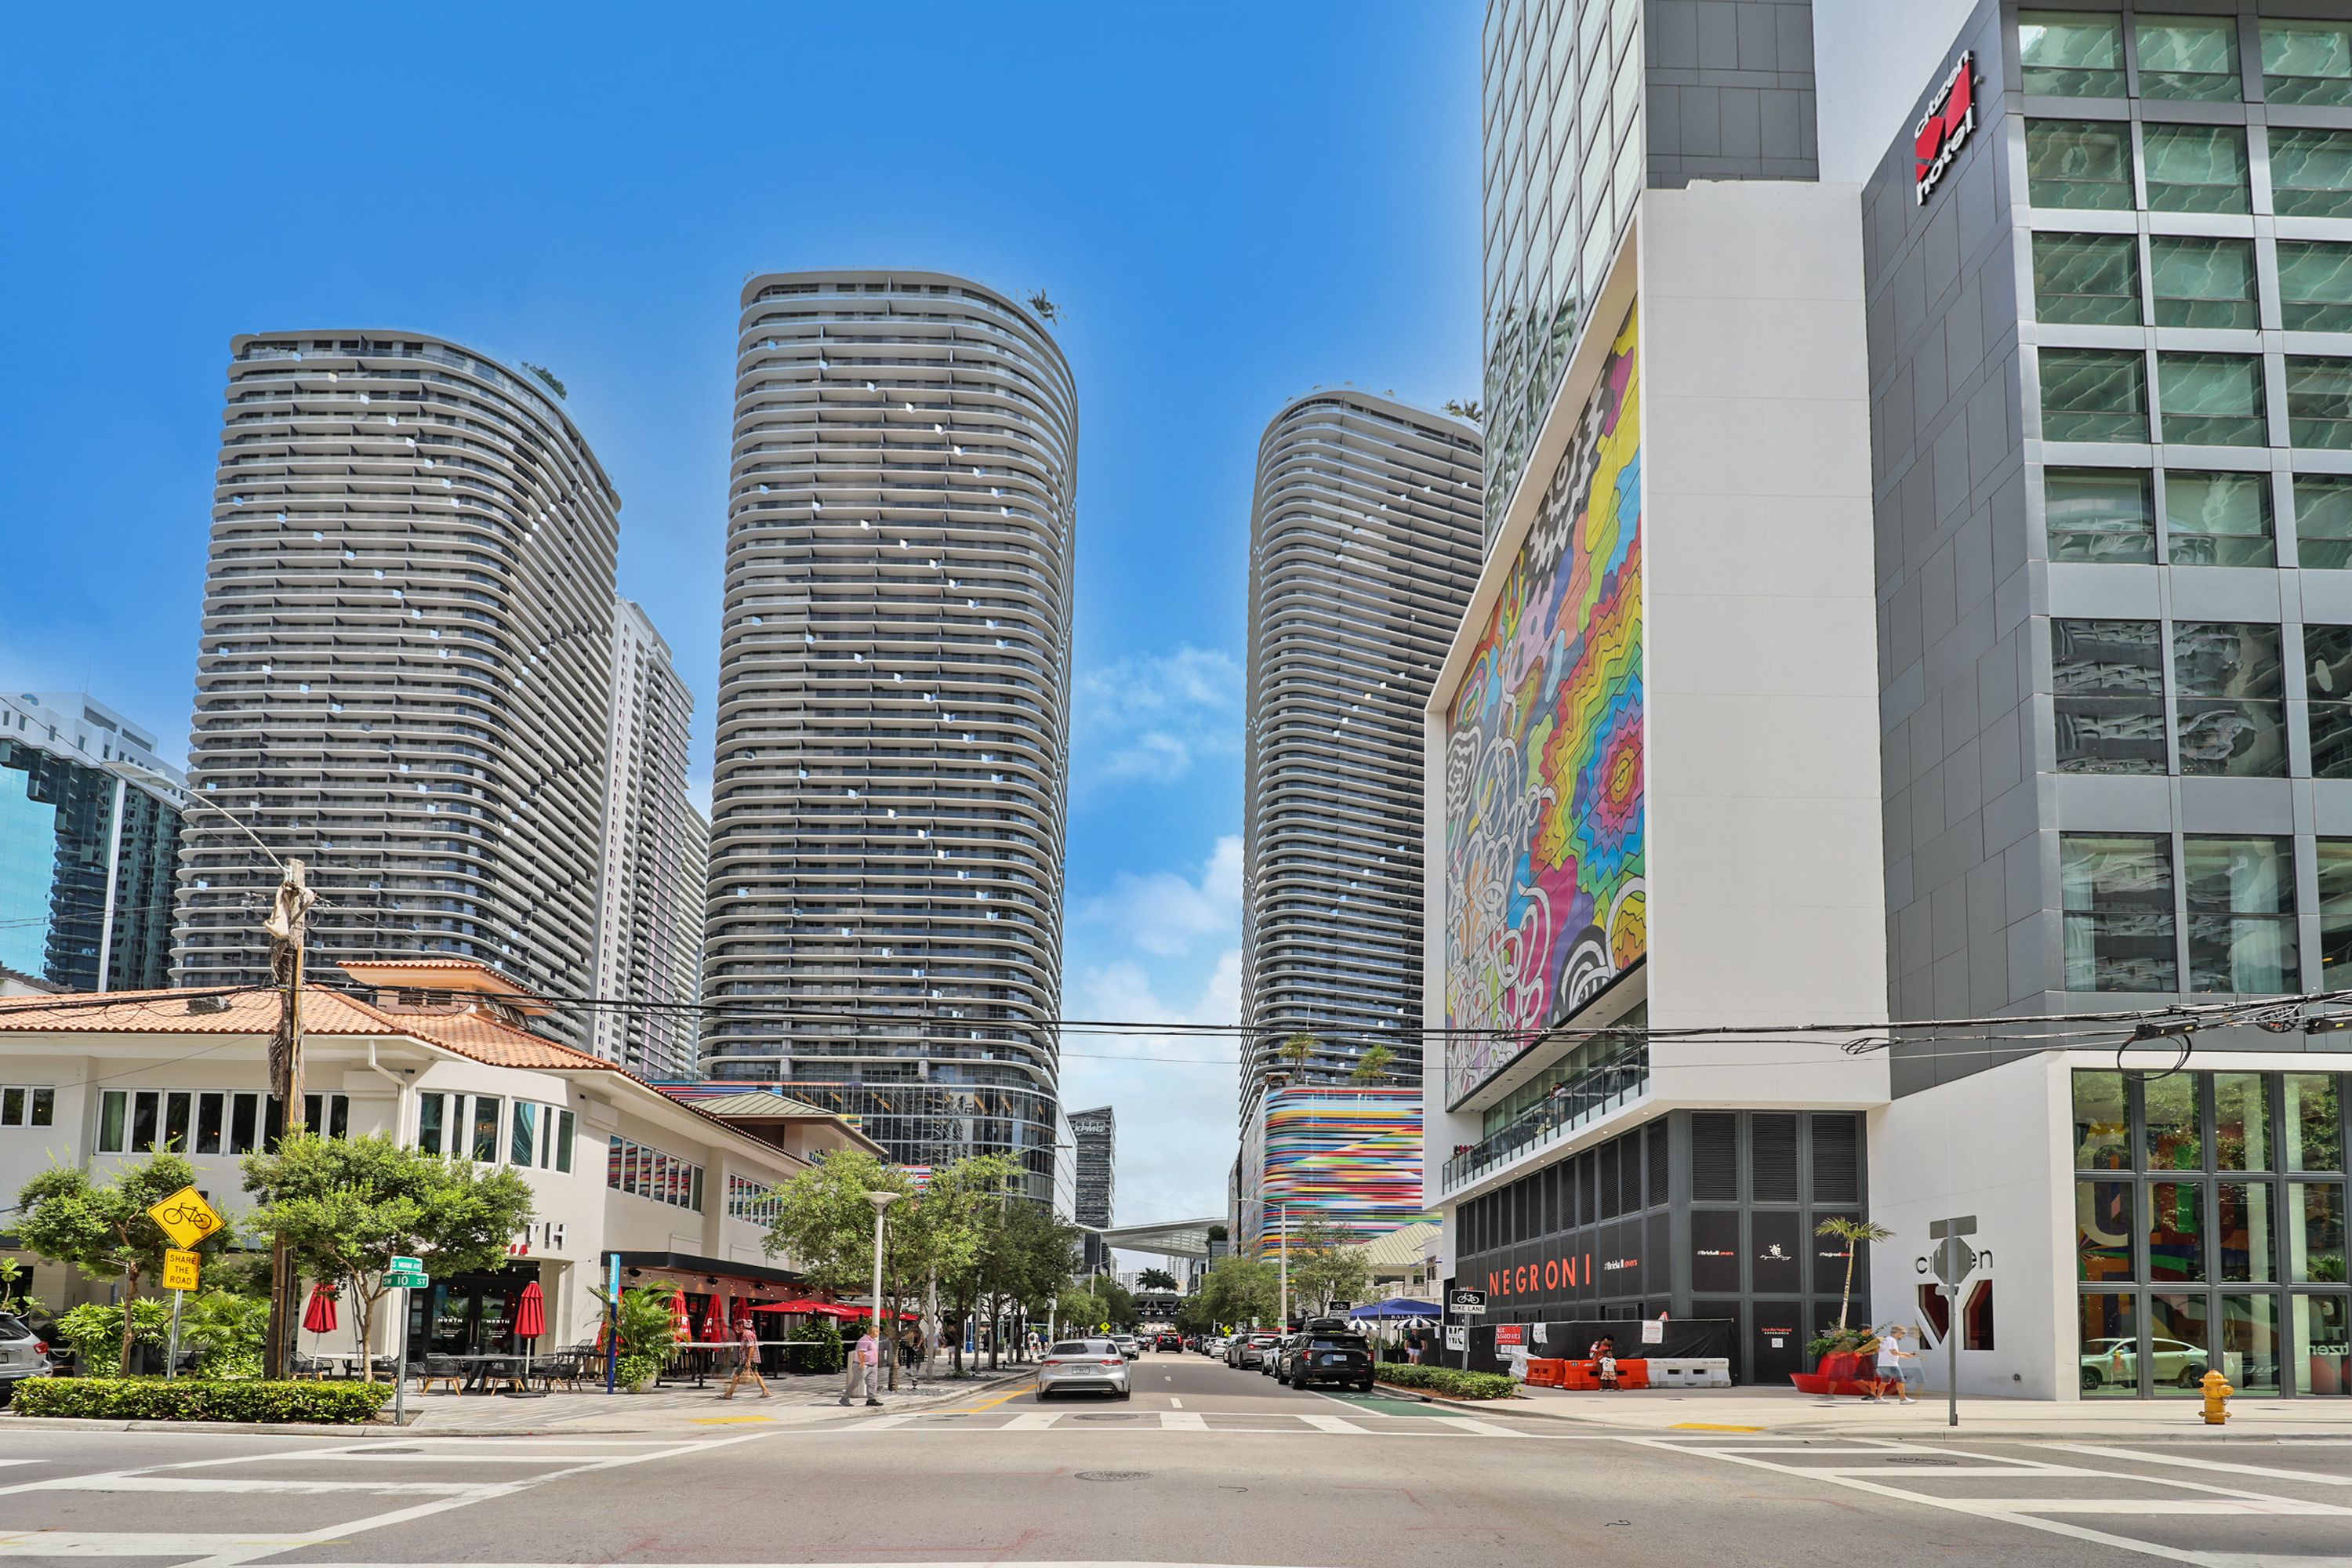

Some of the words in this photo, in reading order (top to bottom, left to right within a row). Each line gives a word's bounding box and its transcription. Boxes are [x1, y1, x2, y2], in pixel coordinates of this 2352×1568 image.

[1915, 49, 1969, 139] citizen
[1916, 106, 1973, 206] hotel
[1074, 1123, 1105, 1133] KPMG
[169, 1254, 196, 1265] SHARE
[175, 1265, 190, 1274] THE
[169, 1276, 192, 1285] ROAD
[397, 1276, 408, 1285] 10
[1490, 1254, 1591, 1297] NEGRONI
